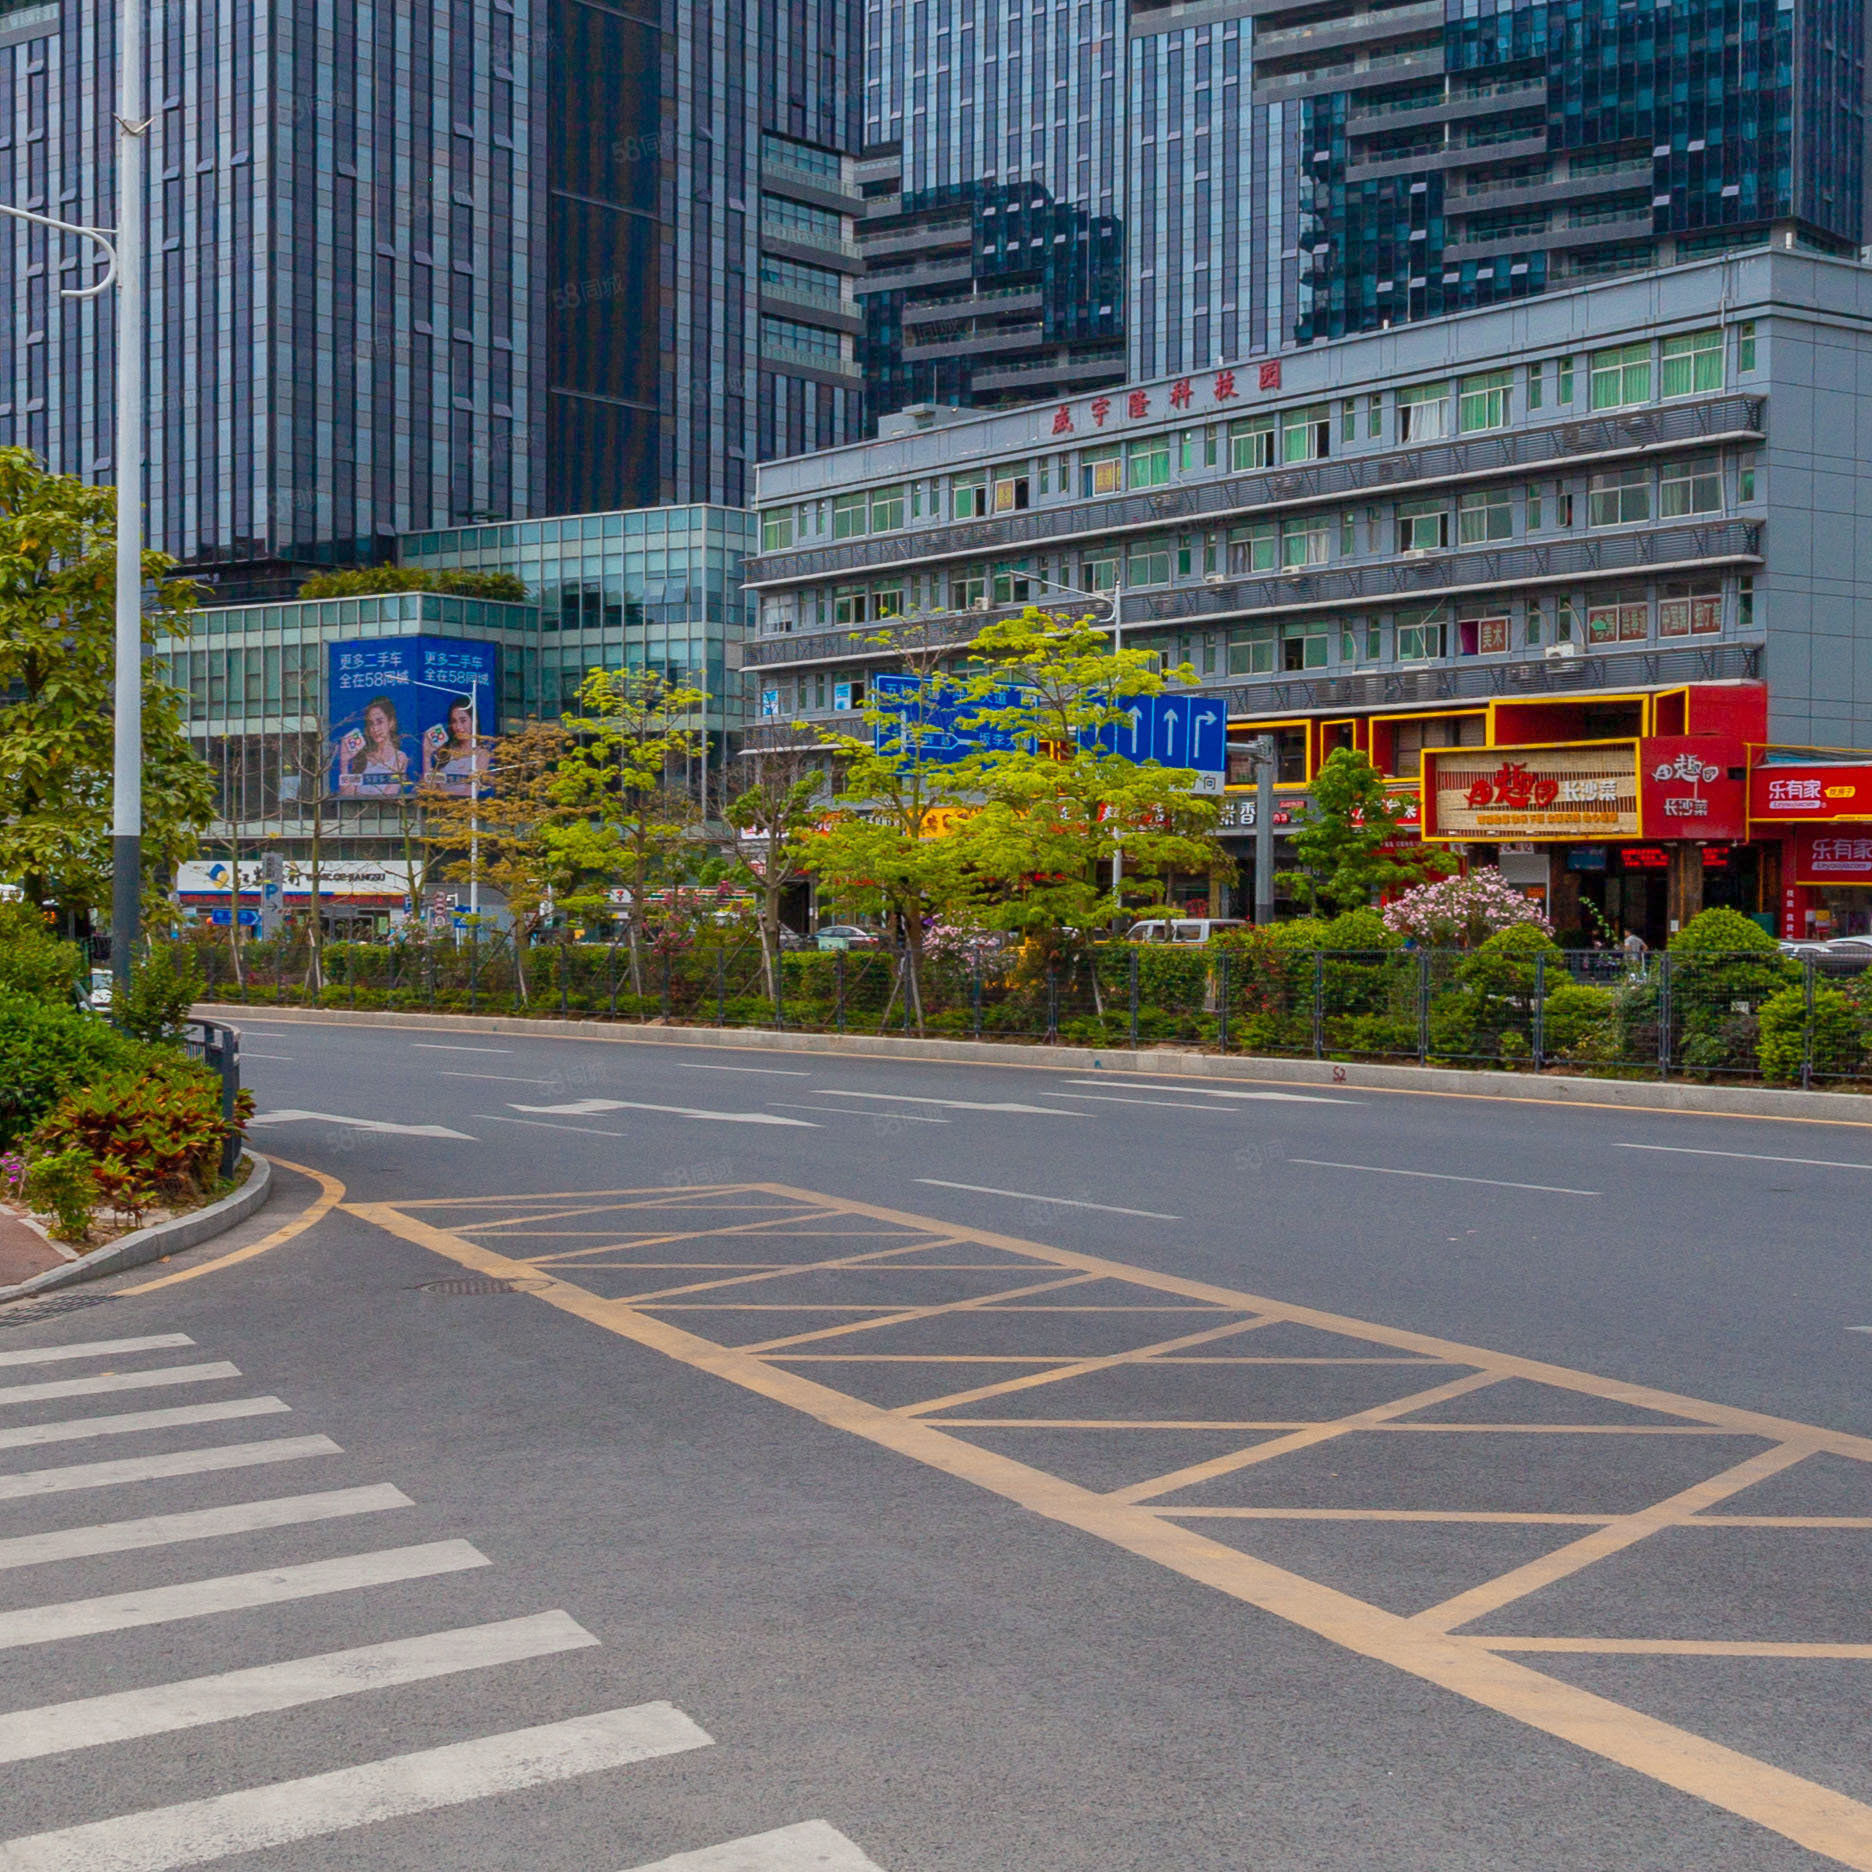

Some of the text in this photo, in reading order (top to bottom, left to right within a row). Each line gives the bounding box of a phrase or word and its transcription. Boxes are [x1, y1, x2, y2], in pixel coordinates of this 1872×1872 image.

[339, 651, 403, 670] 更多二手车
[423, 650, 484, 669] 更多二手车
[339, 669, 410, 689] 全在58同城
[1564, 780, 1617, 802] 长沙菜
[1768, 779, 1822, 799] 乐有家
[1663, 798, 1709, 817] 长沙菜
[265, 883, 279, 900] P
